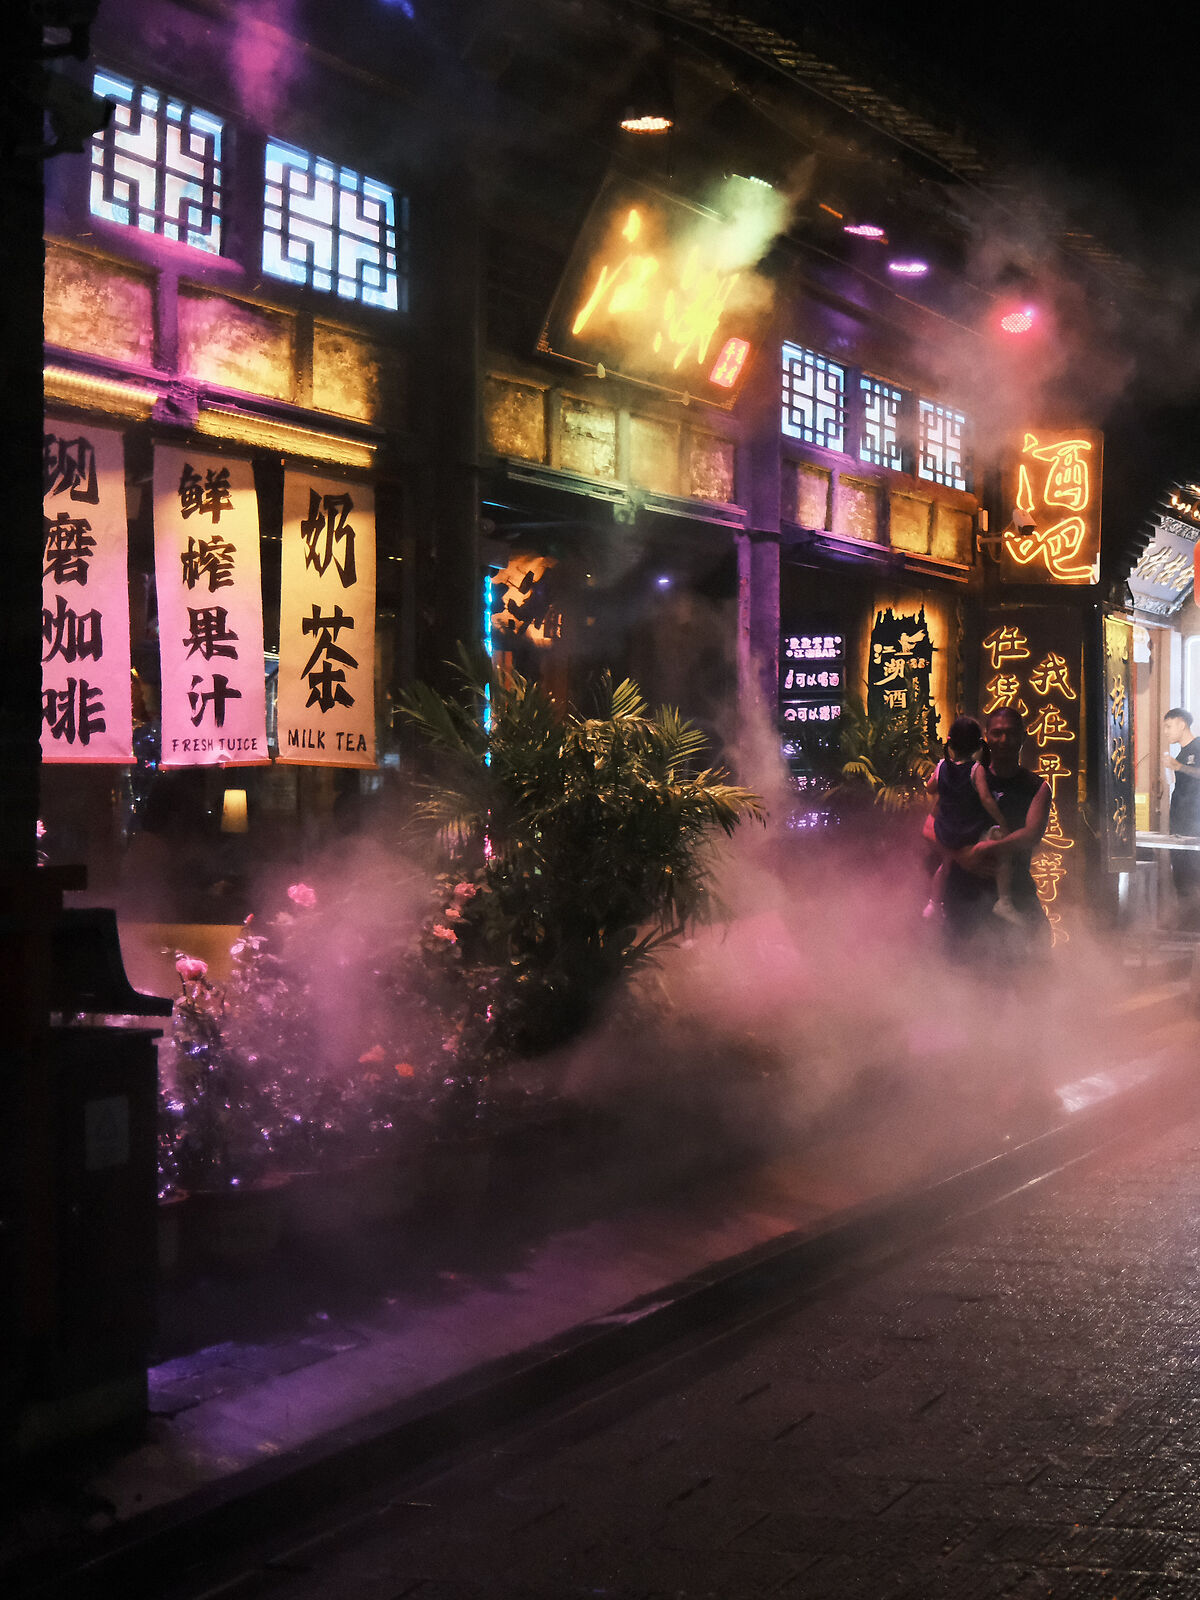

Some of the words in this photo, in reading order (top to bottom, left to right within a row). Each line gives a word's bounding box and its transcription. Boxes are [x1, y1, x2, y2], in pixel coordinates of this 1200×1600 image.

[43, 433, 107, 747] 现磨咖啡
[177, 463, 242, 729] 鲜榨果汁
[1004, 433, 1095, 580] 酒吧
[300, 488, 359, 713] 奶茶
[172, 738, 213, 752] FRESH
[219, 737, 258, 751] JUICE
[288, 729, 325, 750] MILK
[336, 731, 367, 752] TEA
